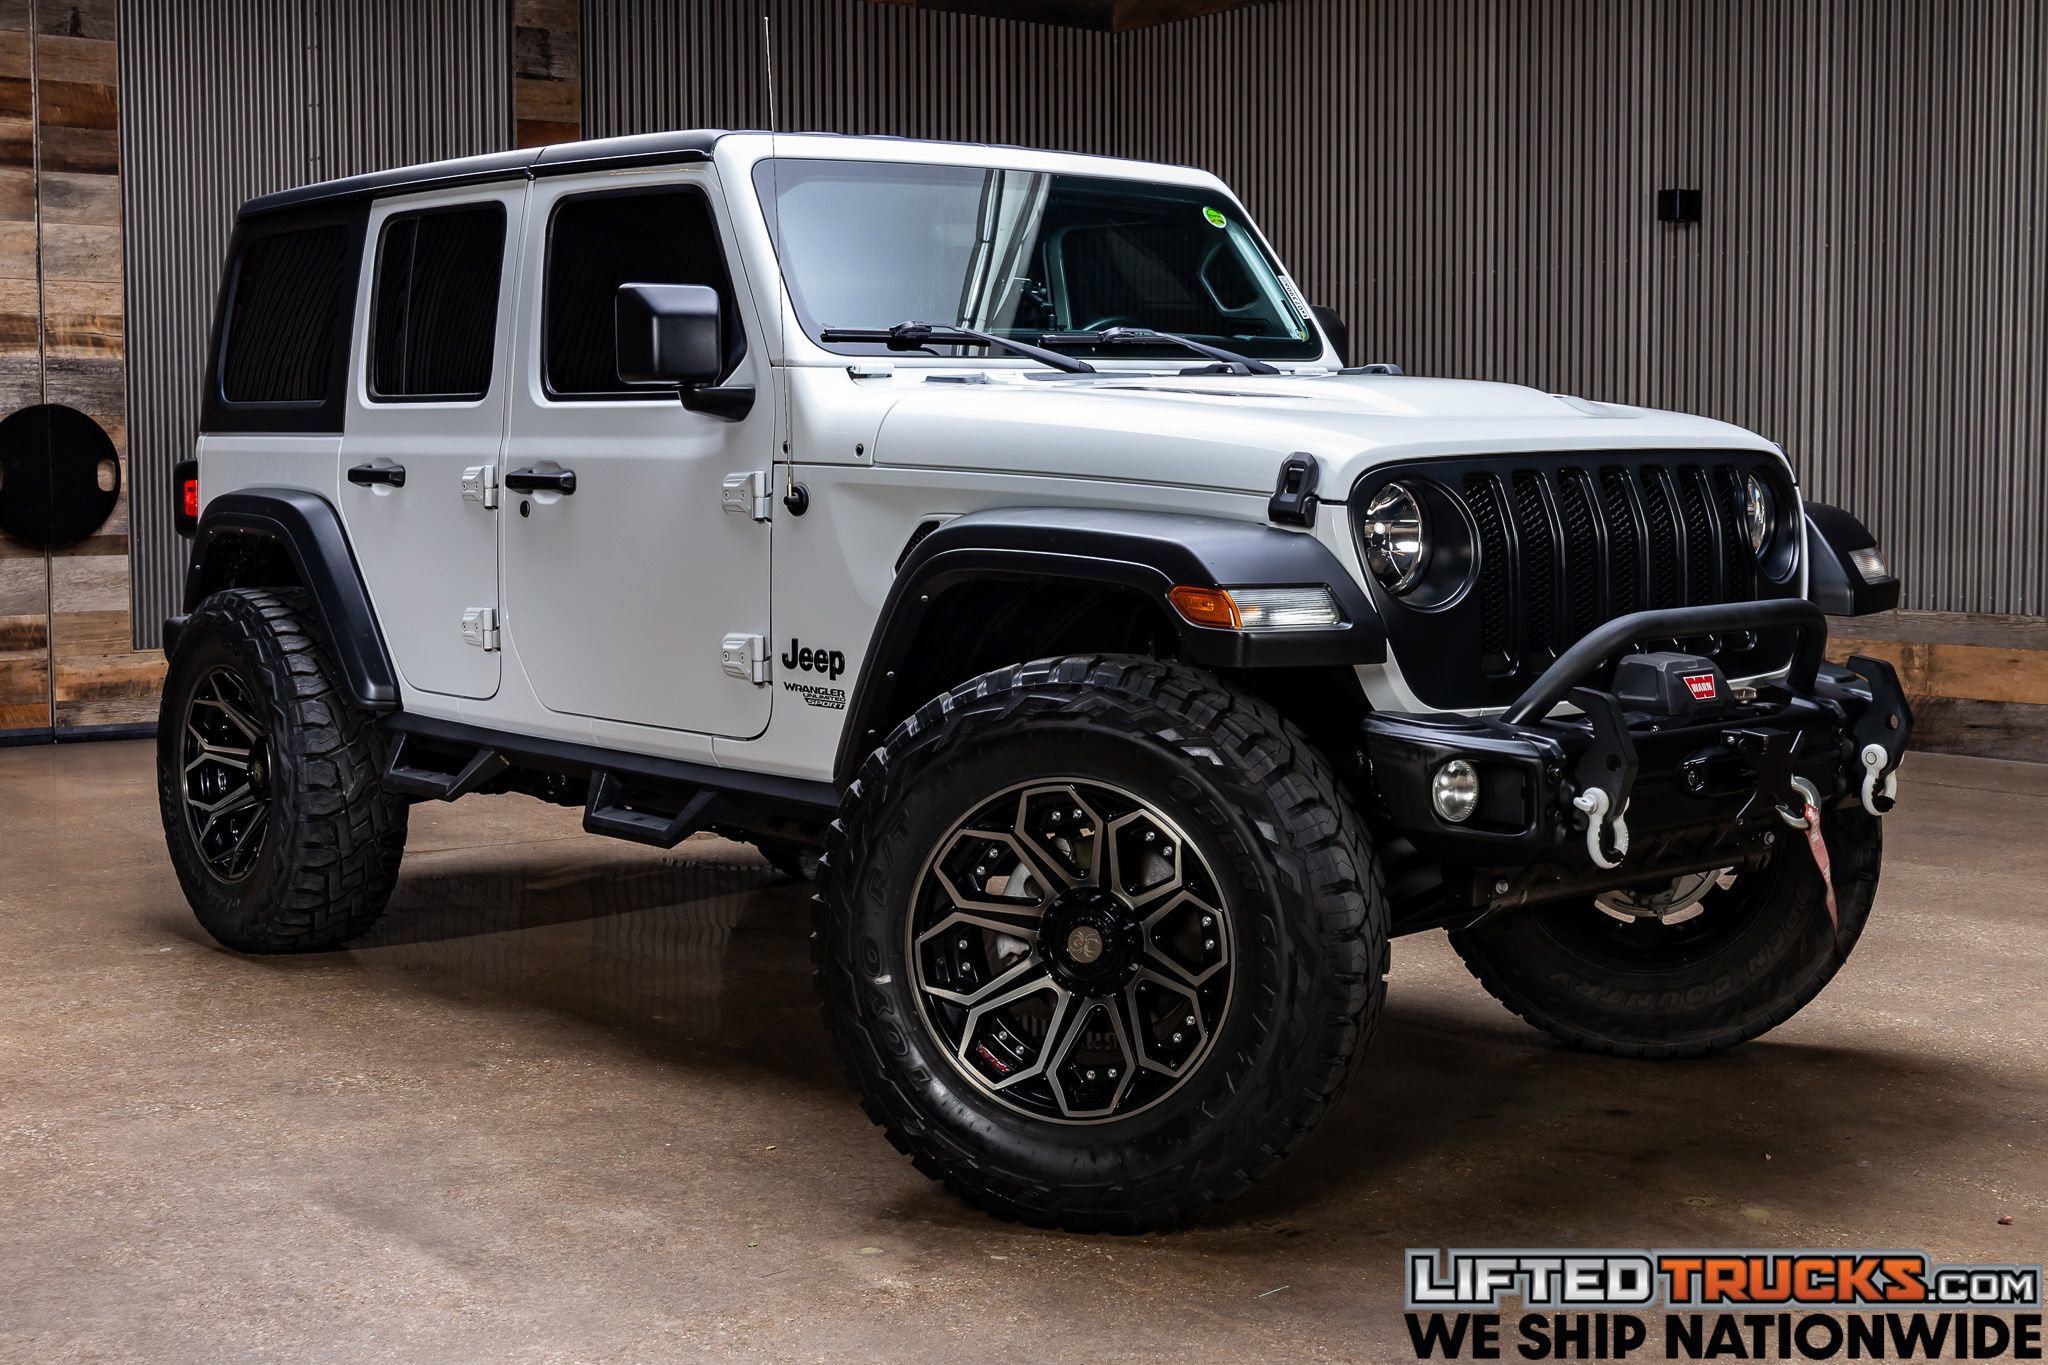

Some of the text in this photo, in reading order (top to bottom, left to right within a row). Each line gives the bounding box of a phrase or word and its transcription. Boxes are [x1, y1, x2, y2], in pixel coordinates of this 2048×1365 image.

[781, 638, 846, 681] Jeep
[783, 681, 846, 698] WRANGLER
[803, 693, 846, 702] UNLIMITED
[807, 699, 845, 709] SPORT
